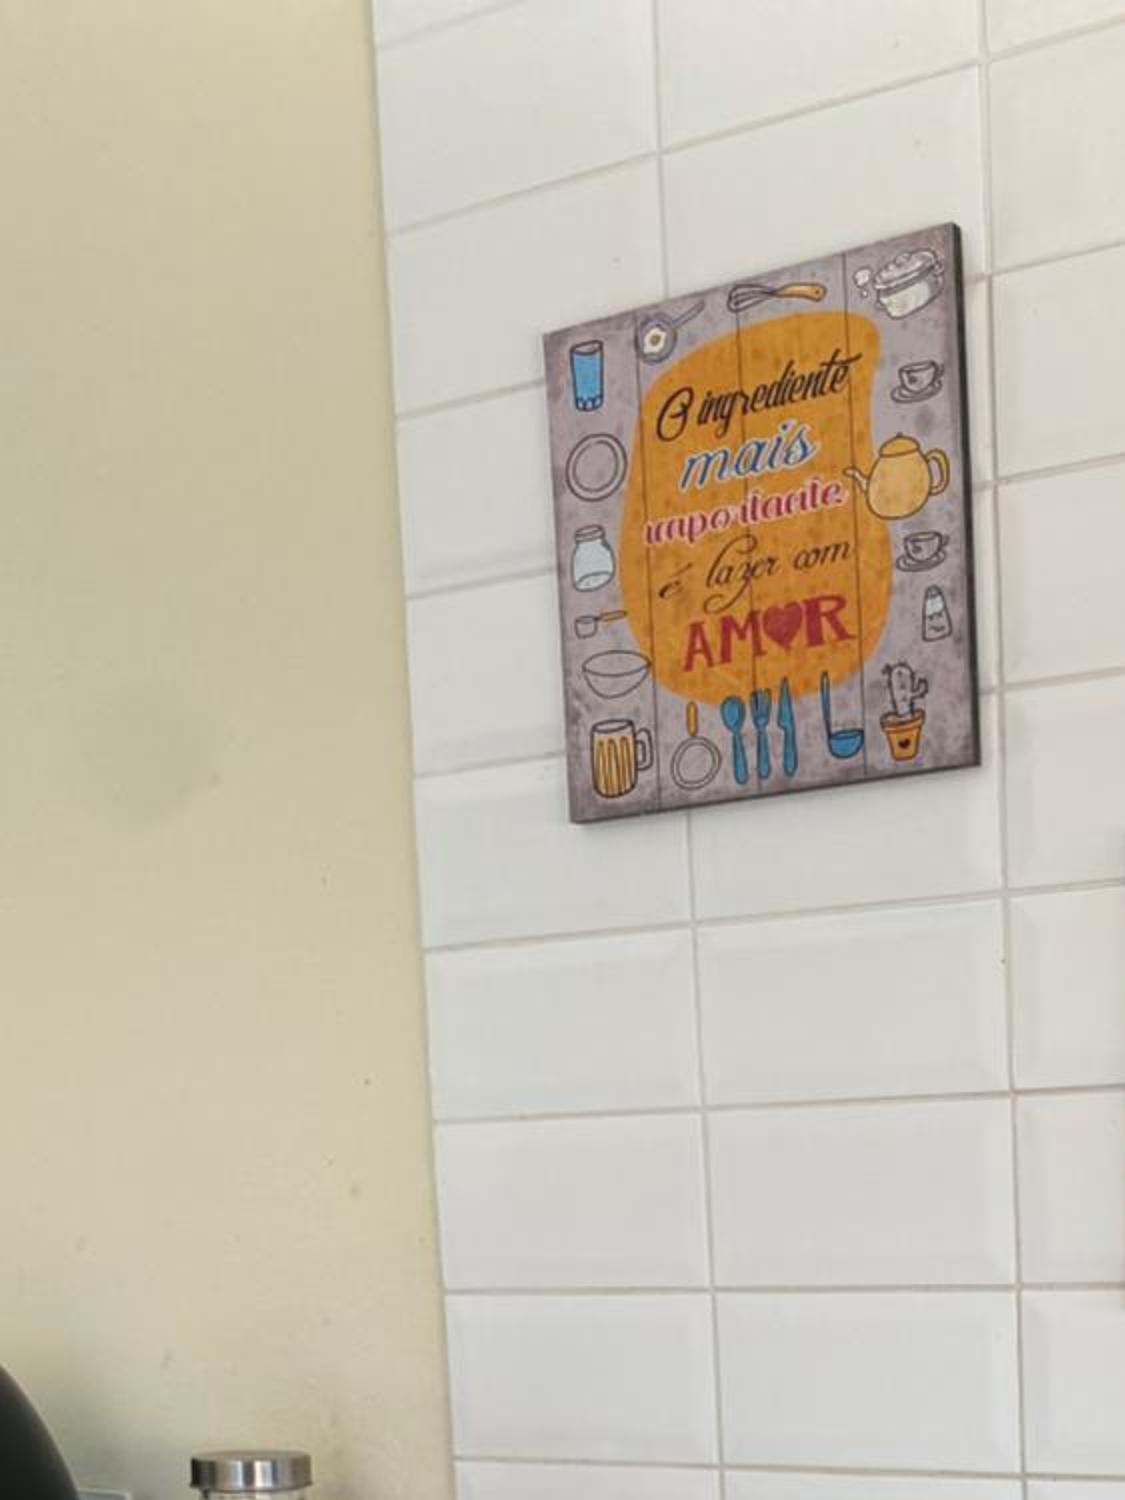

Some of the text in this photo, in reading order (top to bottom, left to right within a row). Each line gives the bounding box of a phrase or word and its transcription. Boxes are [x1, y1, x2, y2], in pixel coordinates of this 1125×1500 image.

[656, 348, 863, 442] O ingrediente
[680, 419, 818, 491] mais
[645, 478, 848, 545] importante
[793, 541, 851, 571] com
